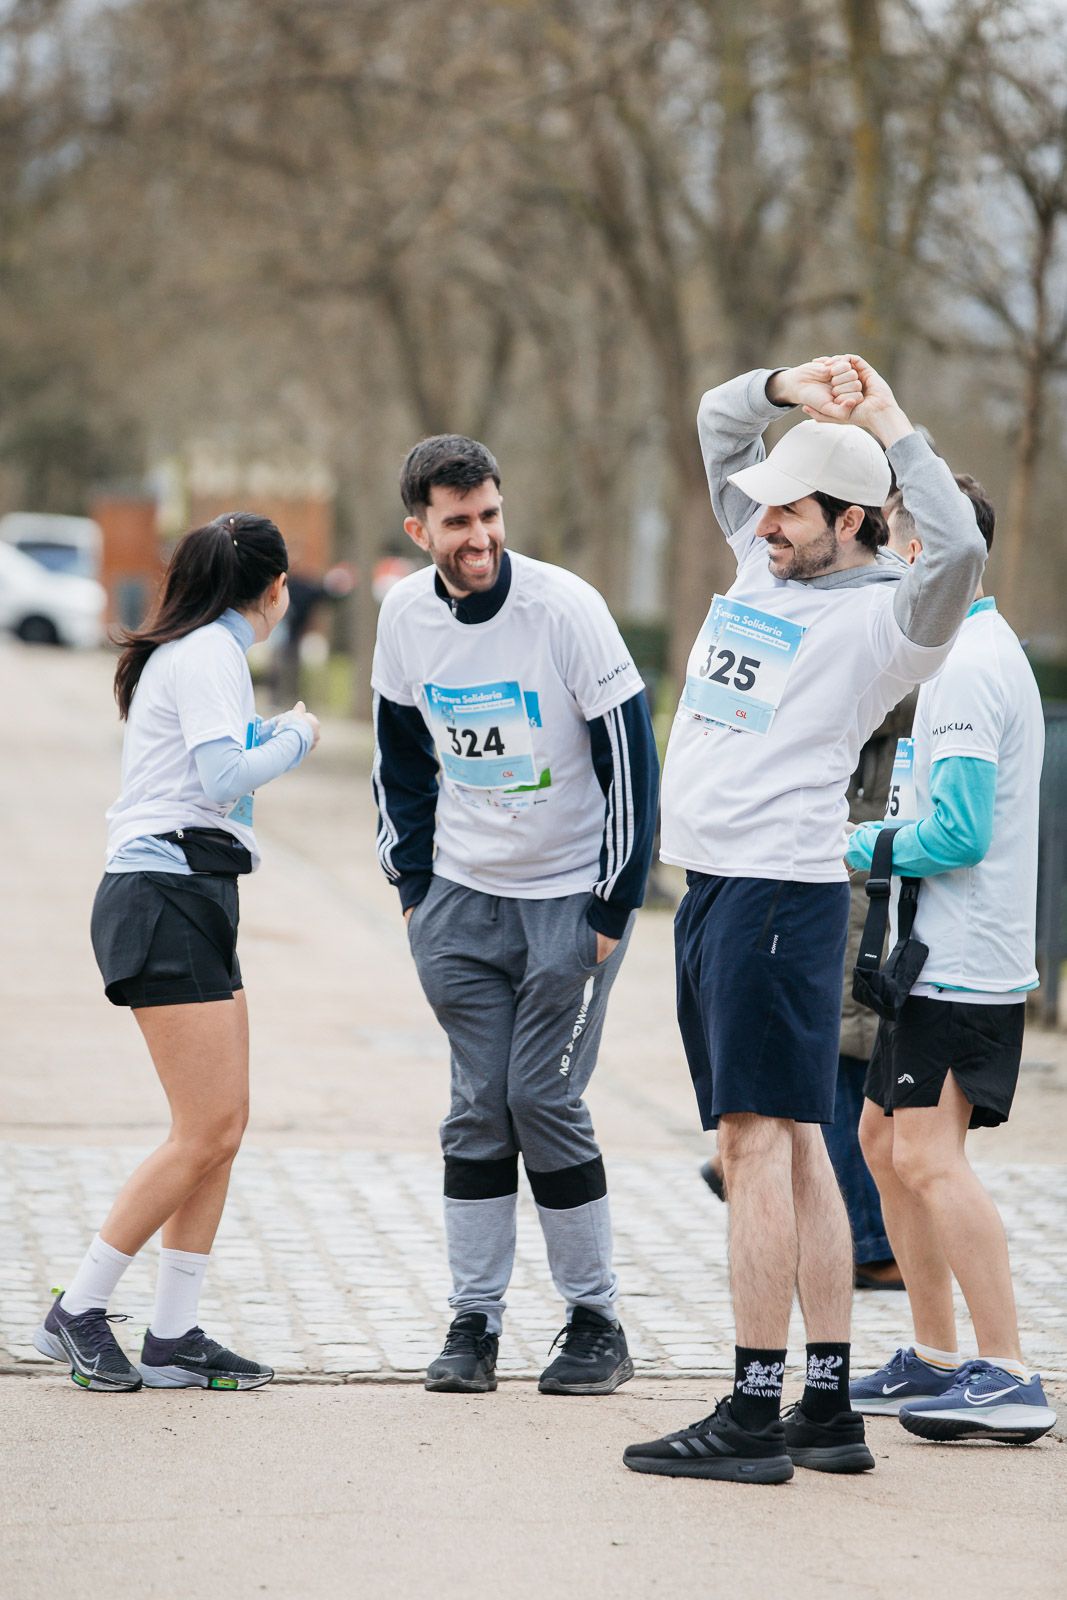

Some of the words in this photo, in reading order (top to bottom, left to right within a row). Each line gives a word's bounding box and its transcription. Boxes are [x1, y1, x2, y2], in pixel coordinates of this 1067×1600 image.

[742, 615, 783, 637] Solidaria
[700, 645, 761, 691] 325
[461, 690, 503, 704] Solidaria
[735, 709, 747, 719] CSL
[932, 722, 974, 735] MUKUA
[446, 726, 506, 758] 324
[742, 1386, 782, 1398] BRAVING
